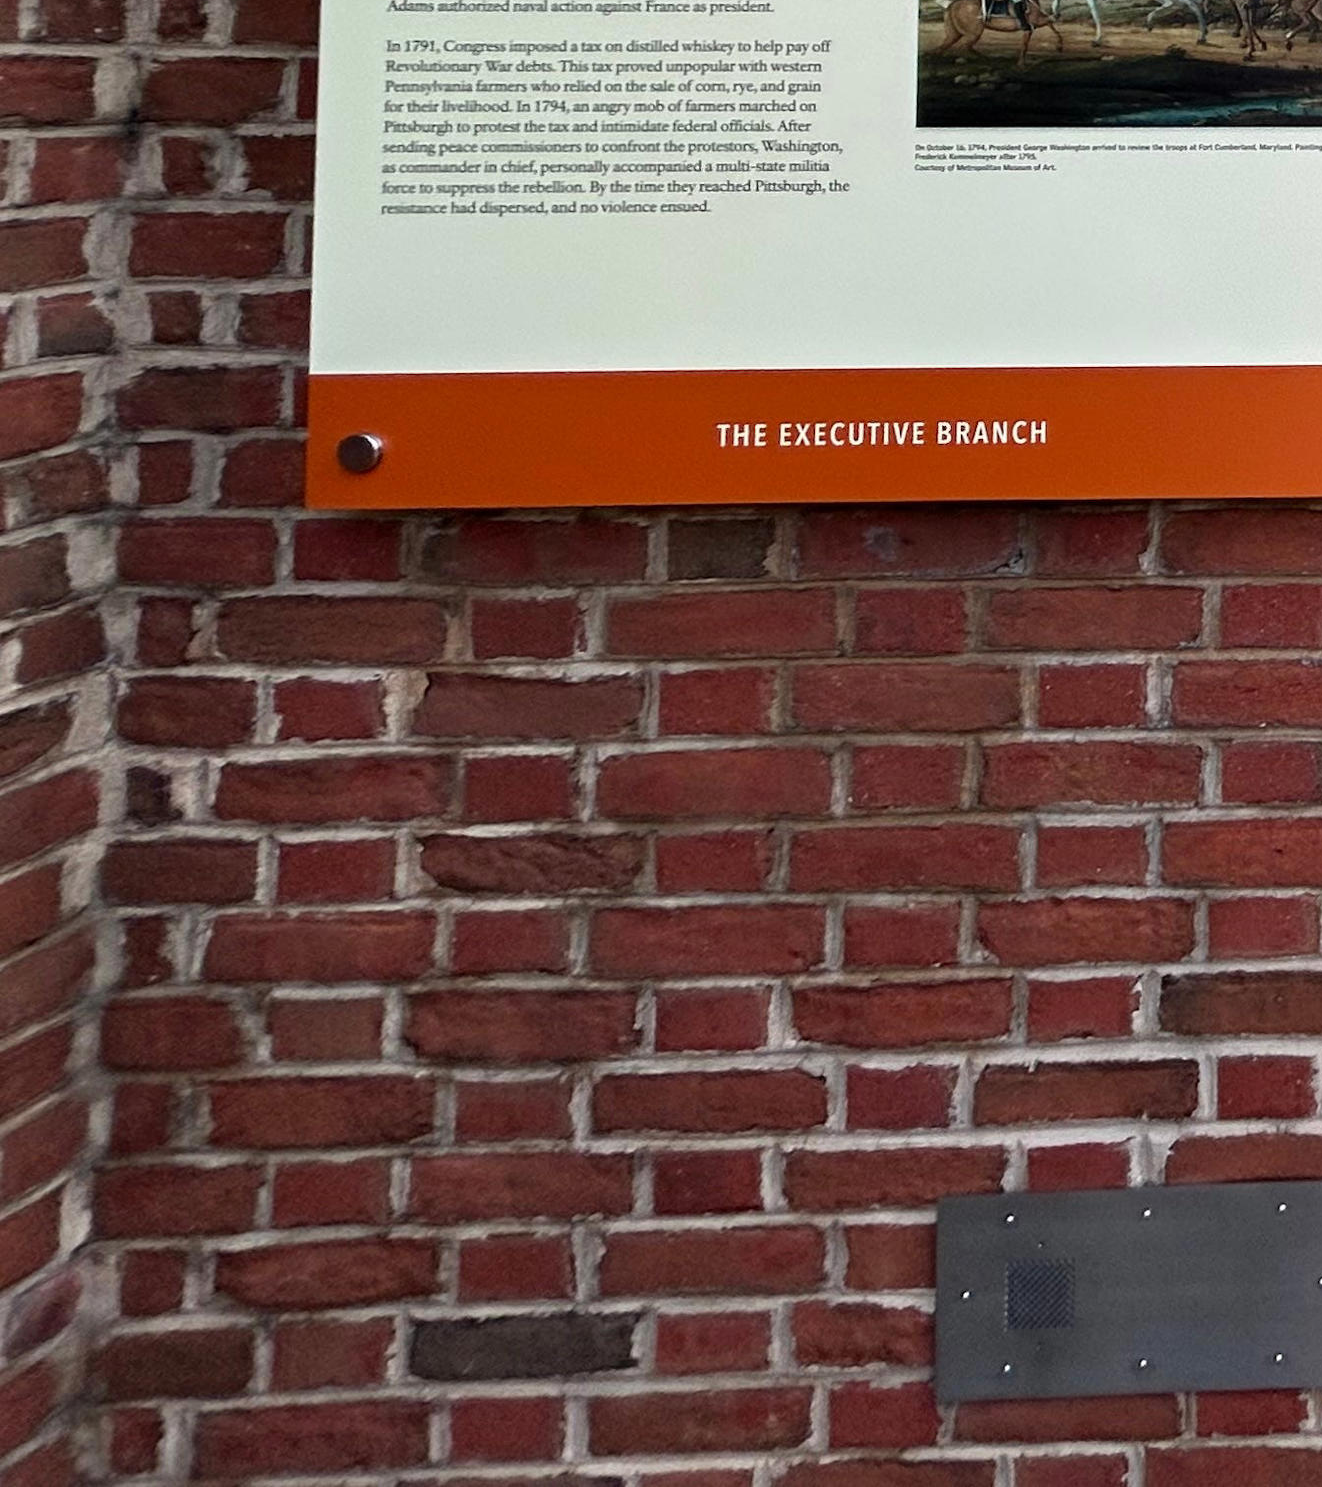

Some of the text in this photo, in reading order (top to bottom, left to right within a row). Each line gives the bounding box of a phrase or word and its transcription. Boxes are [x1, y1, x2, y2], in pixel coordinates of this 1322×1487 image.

[717, 420, 1046, 447] THE EXECUTIVE BRANCH
